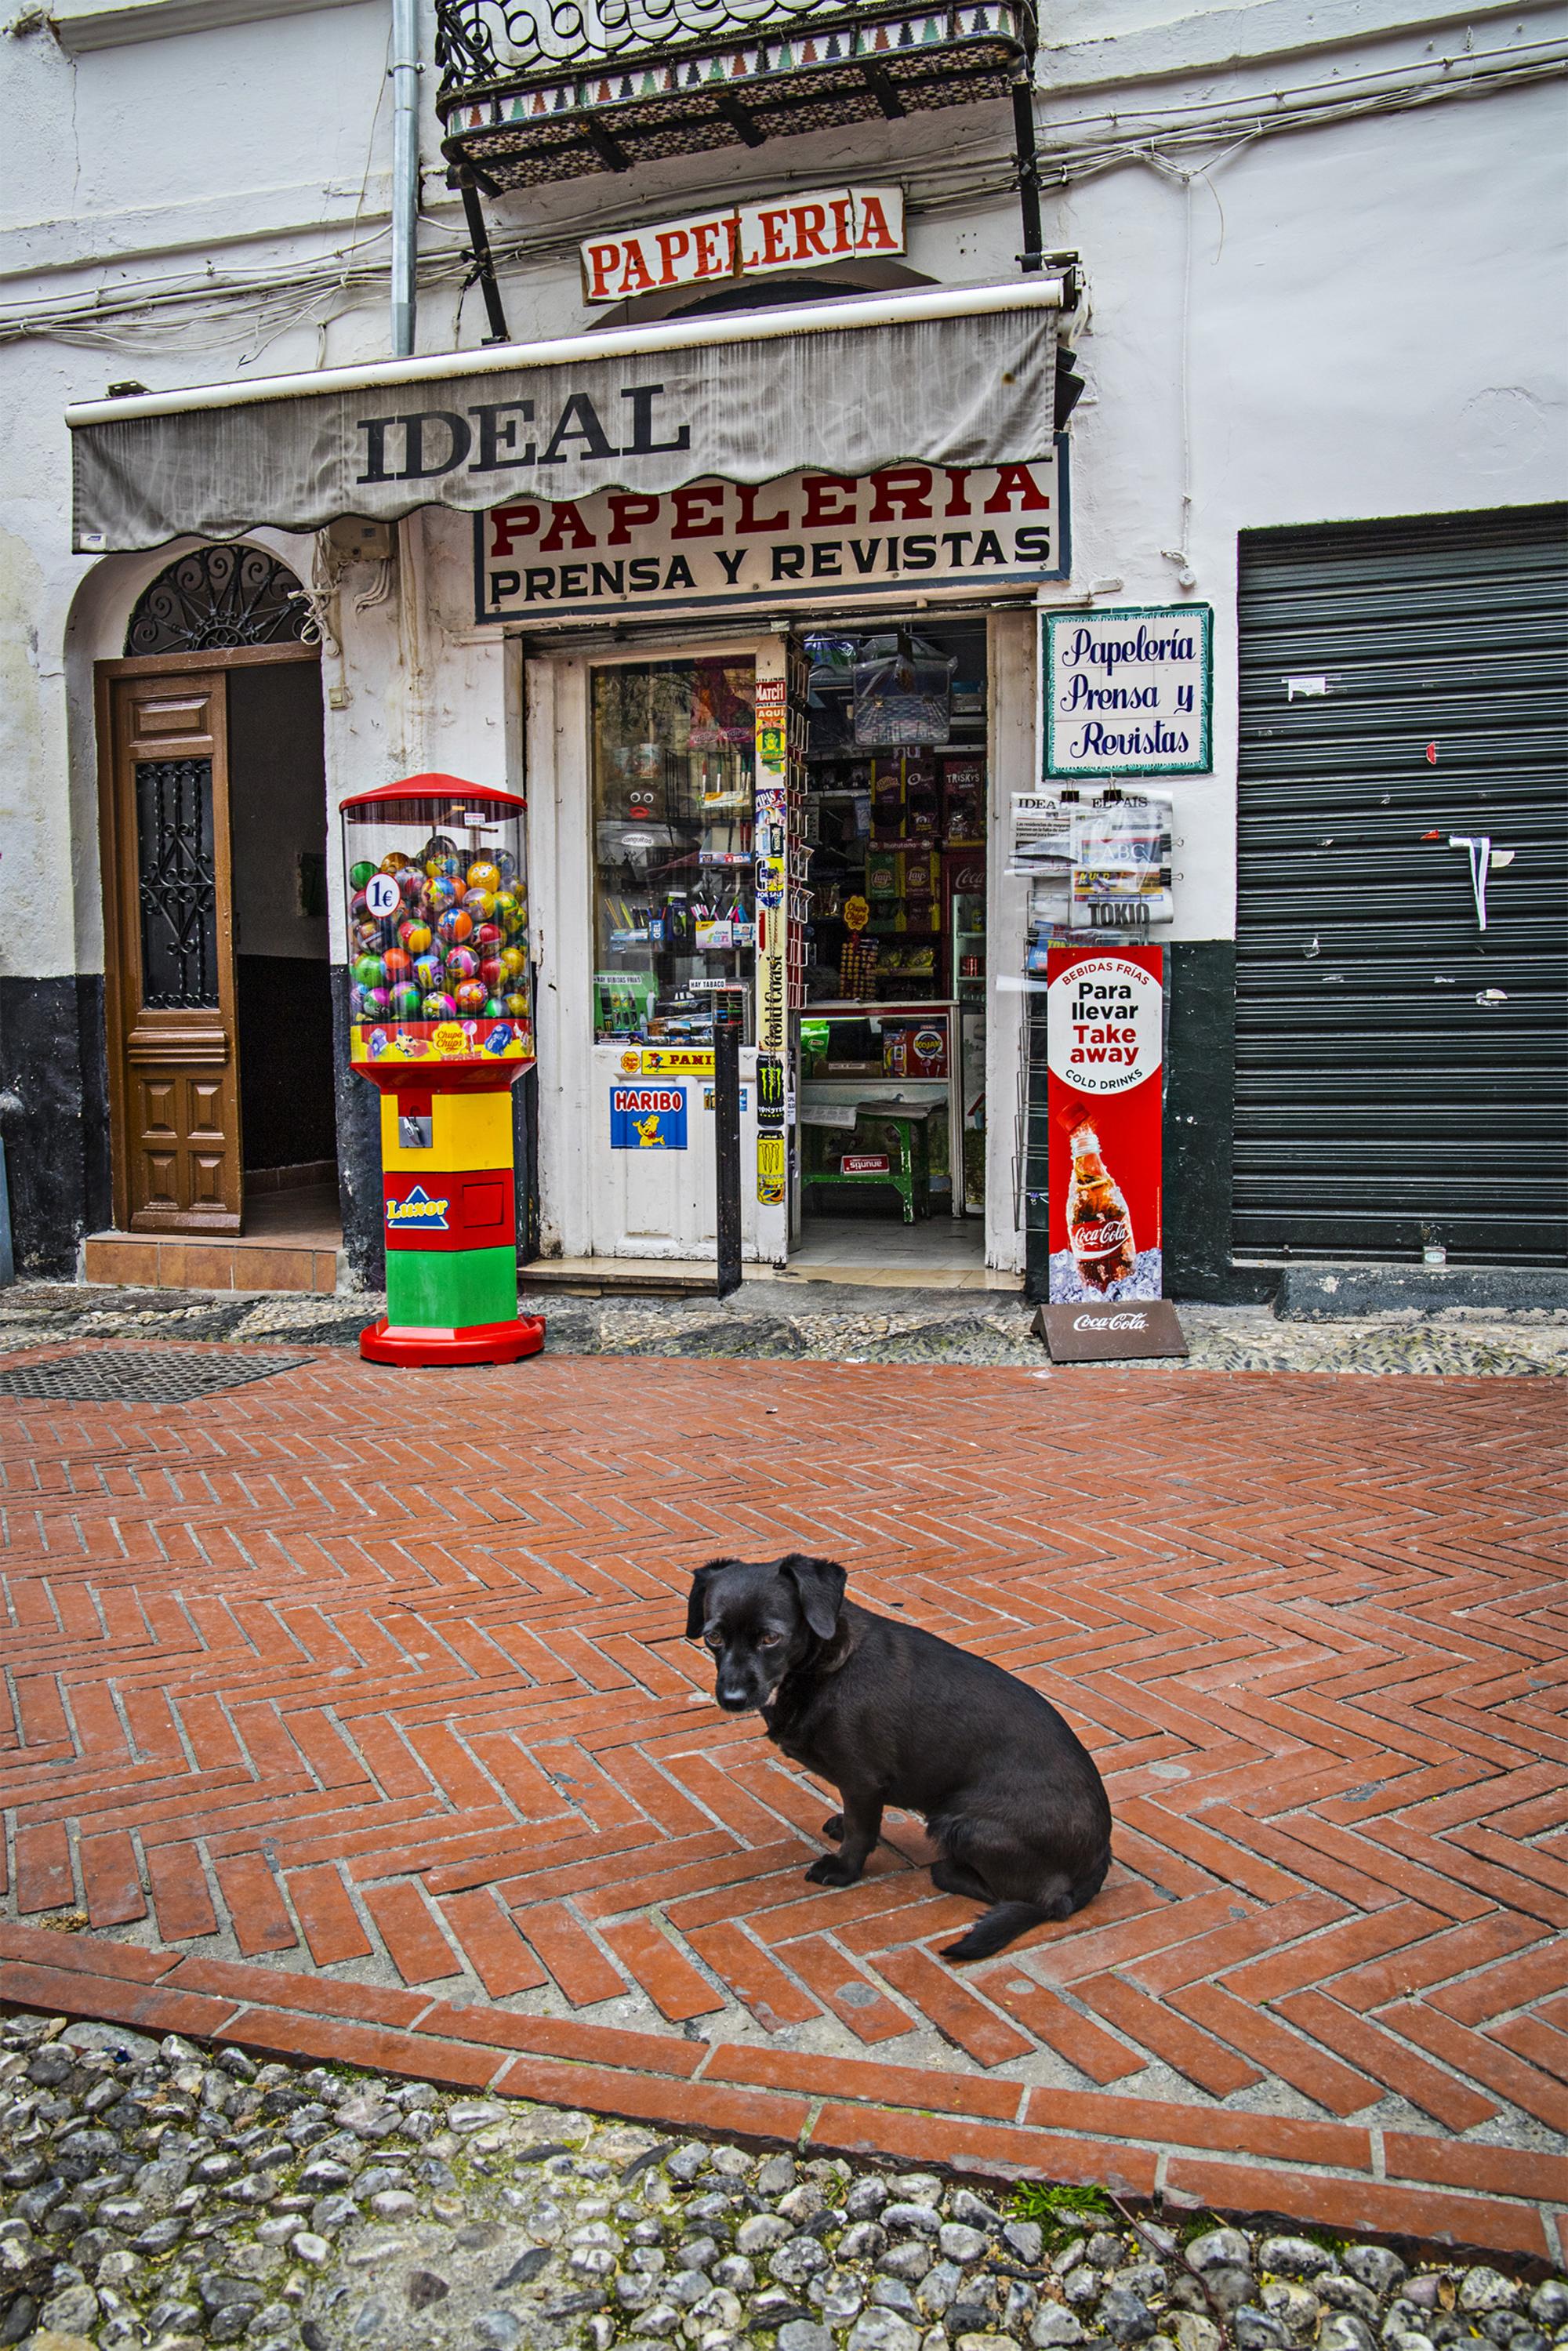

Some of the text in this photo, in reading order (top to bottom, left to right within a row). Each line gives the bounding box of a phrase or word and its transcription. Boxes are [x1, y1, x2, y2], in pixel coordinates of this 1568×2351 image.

[588, 198, 898, 297] PAPELERIA
[357, 384, 691, 484] IDEAL
[490, 464, 1051, 557] PAPELERIA
[491, 526, 1051, 604] PRENSA Y REVISTAS
[1062, 625, 1196, 677] Papelería
[1060, 673, 1194, 714] Prensa y
[1069, 720, 1189, 759] Revistas
[372, 881, 393, 907] 1€
[1088, 903, 1150, 927] TOKIO
[1062, 963, 1150, 985] BEBIDAS FRÍAS
[1079, 982, 1131, 1000] Para
[1072, 1002, 1138, 1020] llevar
[437, 1031, 463, 1039] Chupa
[437, 1039, 462, 1048] Chups
[1073, 1024, 1137, 1044] Take
[670, 1055, 716, 1065] PANI
[1070, 1047, 1139, 1066] away
[1065, 1068, 1143, 1089] COLD DRINKS
[615, 1090, 682, 1112] HARIBO
[387, 1200, 448, 1219] Luxor
[1075, 1221, 1127, 1247] Coca-Cola
[1073, 1313, 1149, 1331] Coca-Cola
